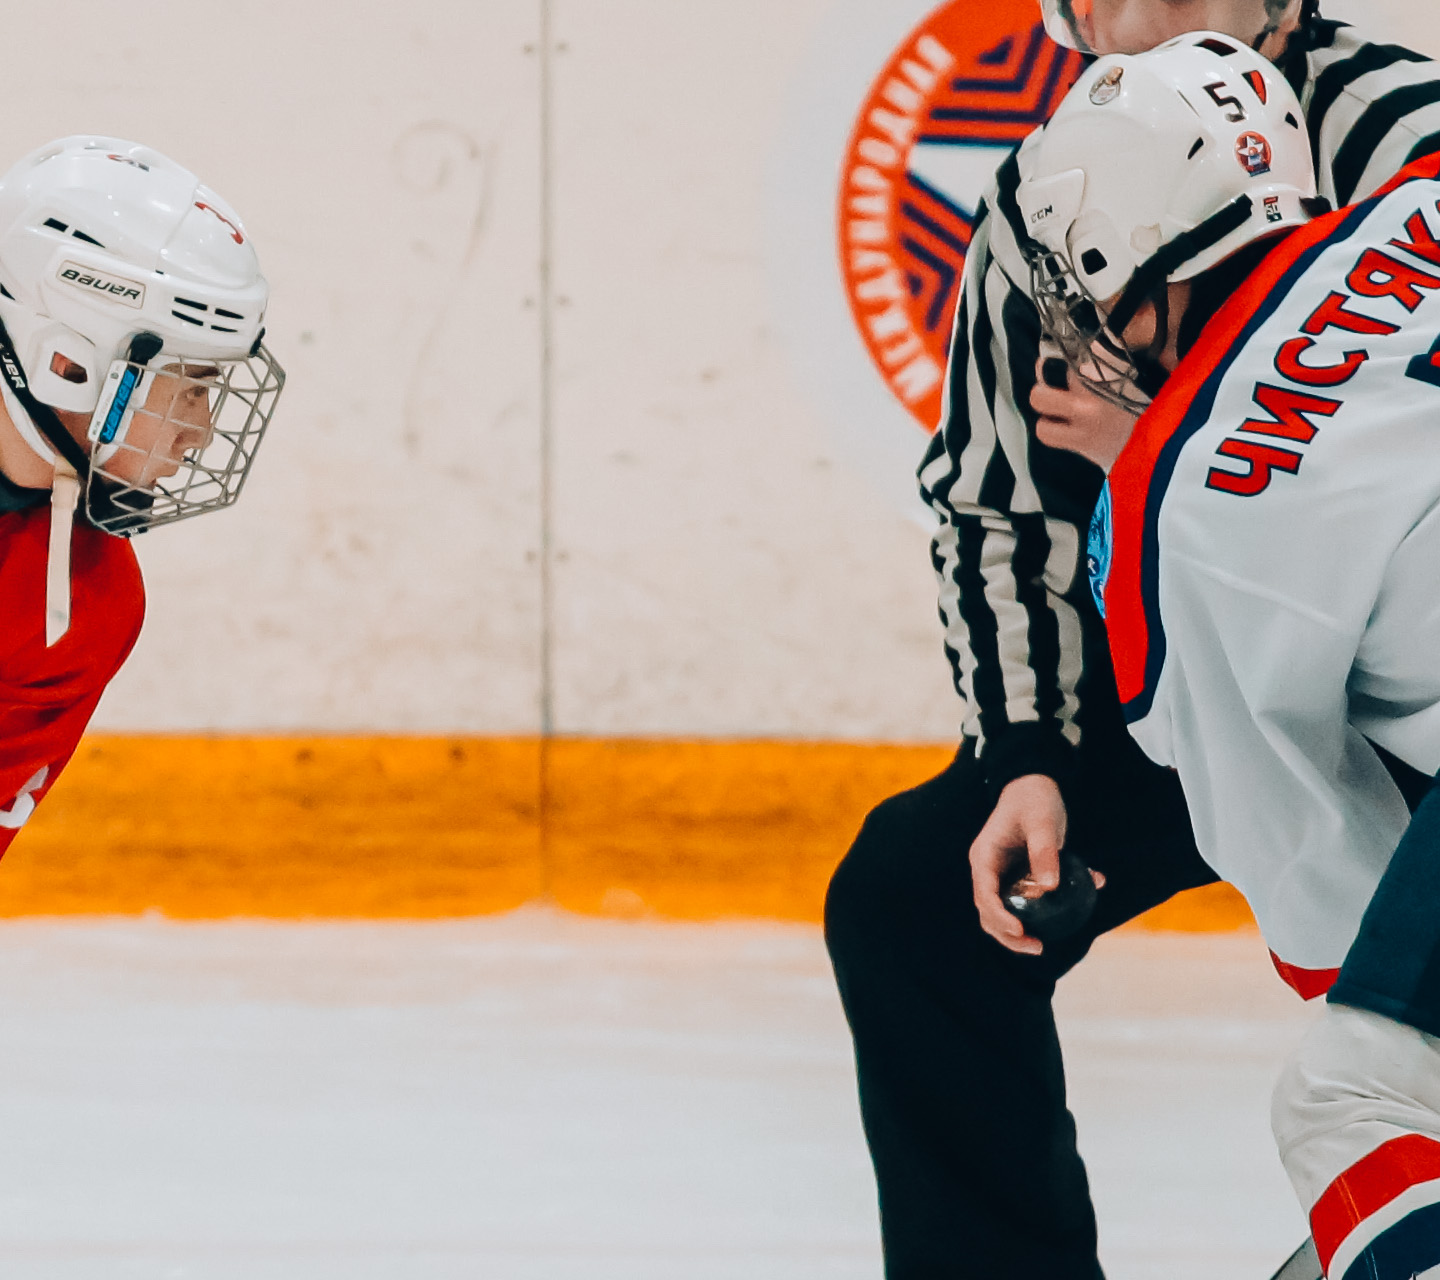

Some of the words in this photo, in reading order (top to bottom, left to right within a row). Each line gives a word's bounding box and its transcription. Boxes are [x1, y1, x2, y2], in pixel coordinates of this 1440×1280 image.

[1203, 80, 1247, 122] 5
[1031, 204, 1053, 223] CCM
[61, 269, 141, 301] BAUER
